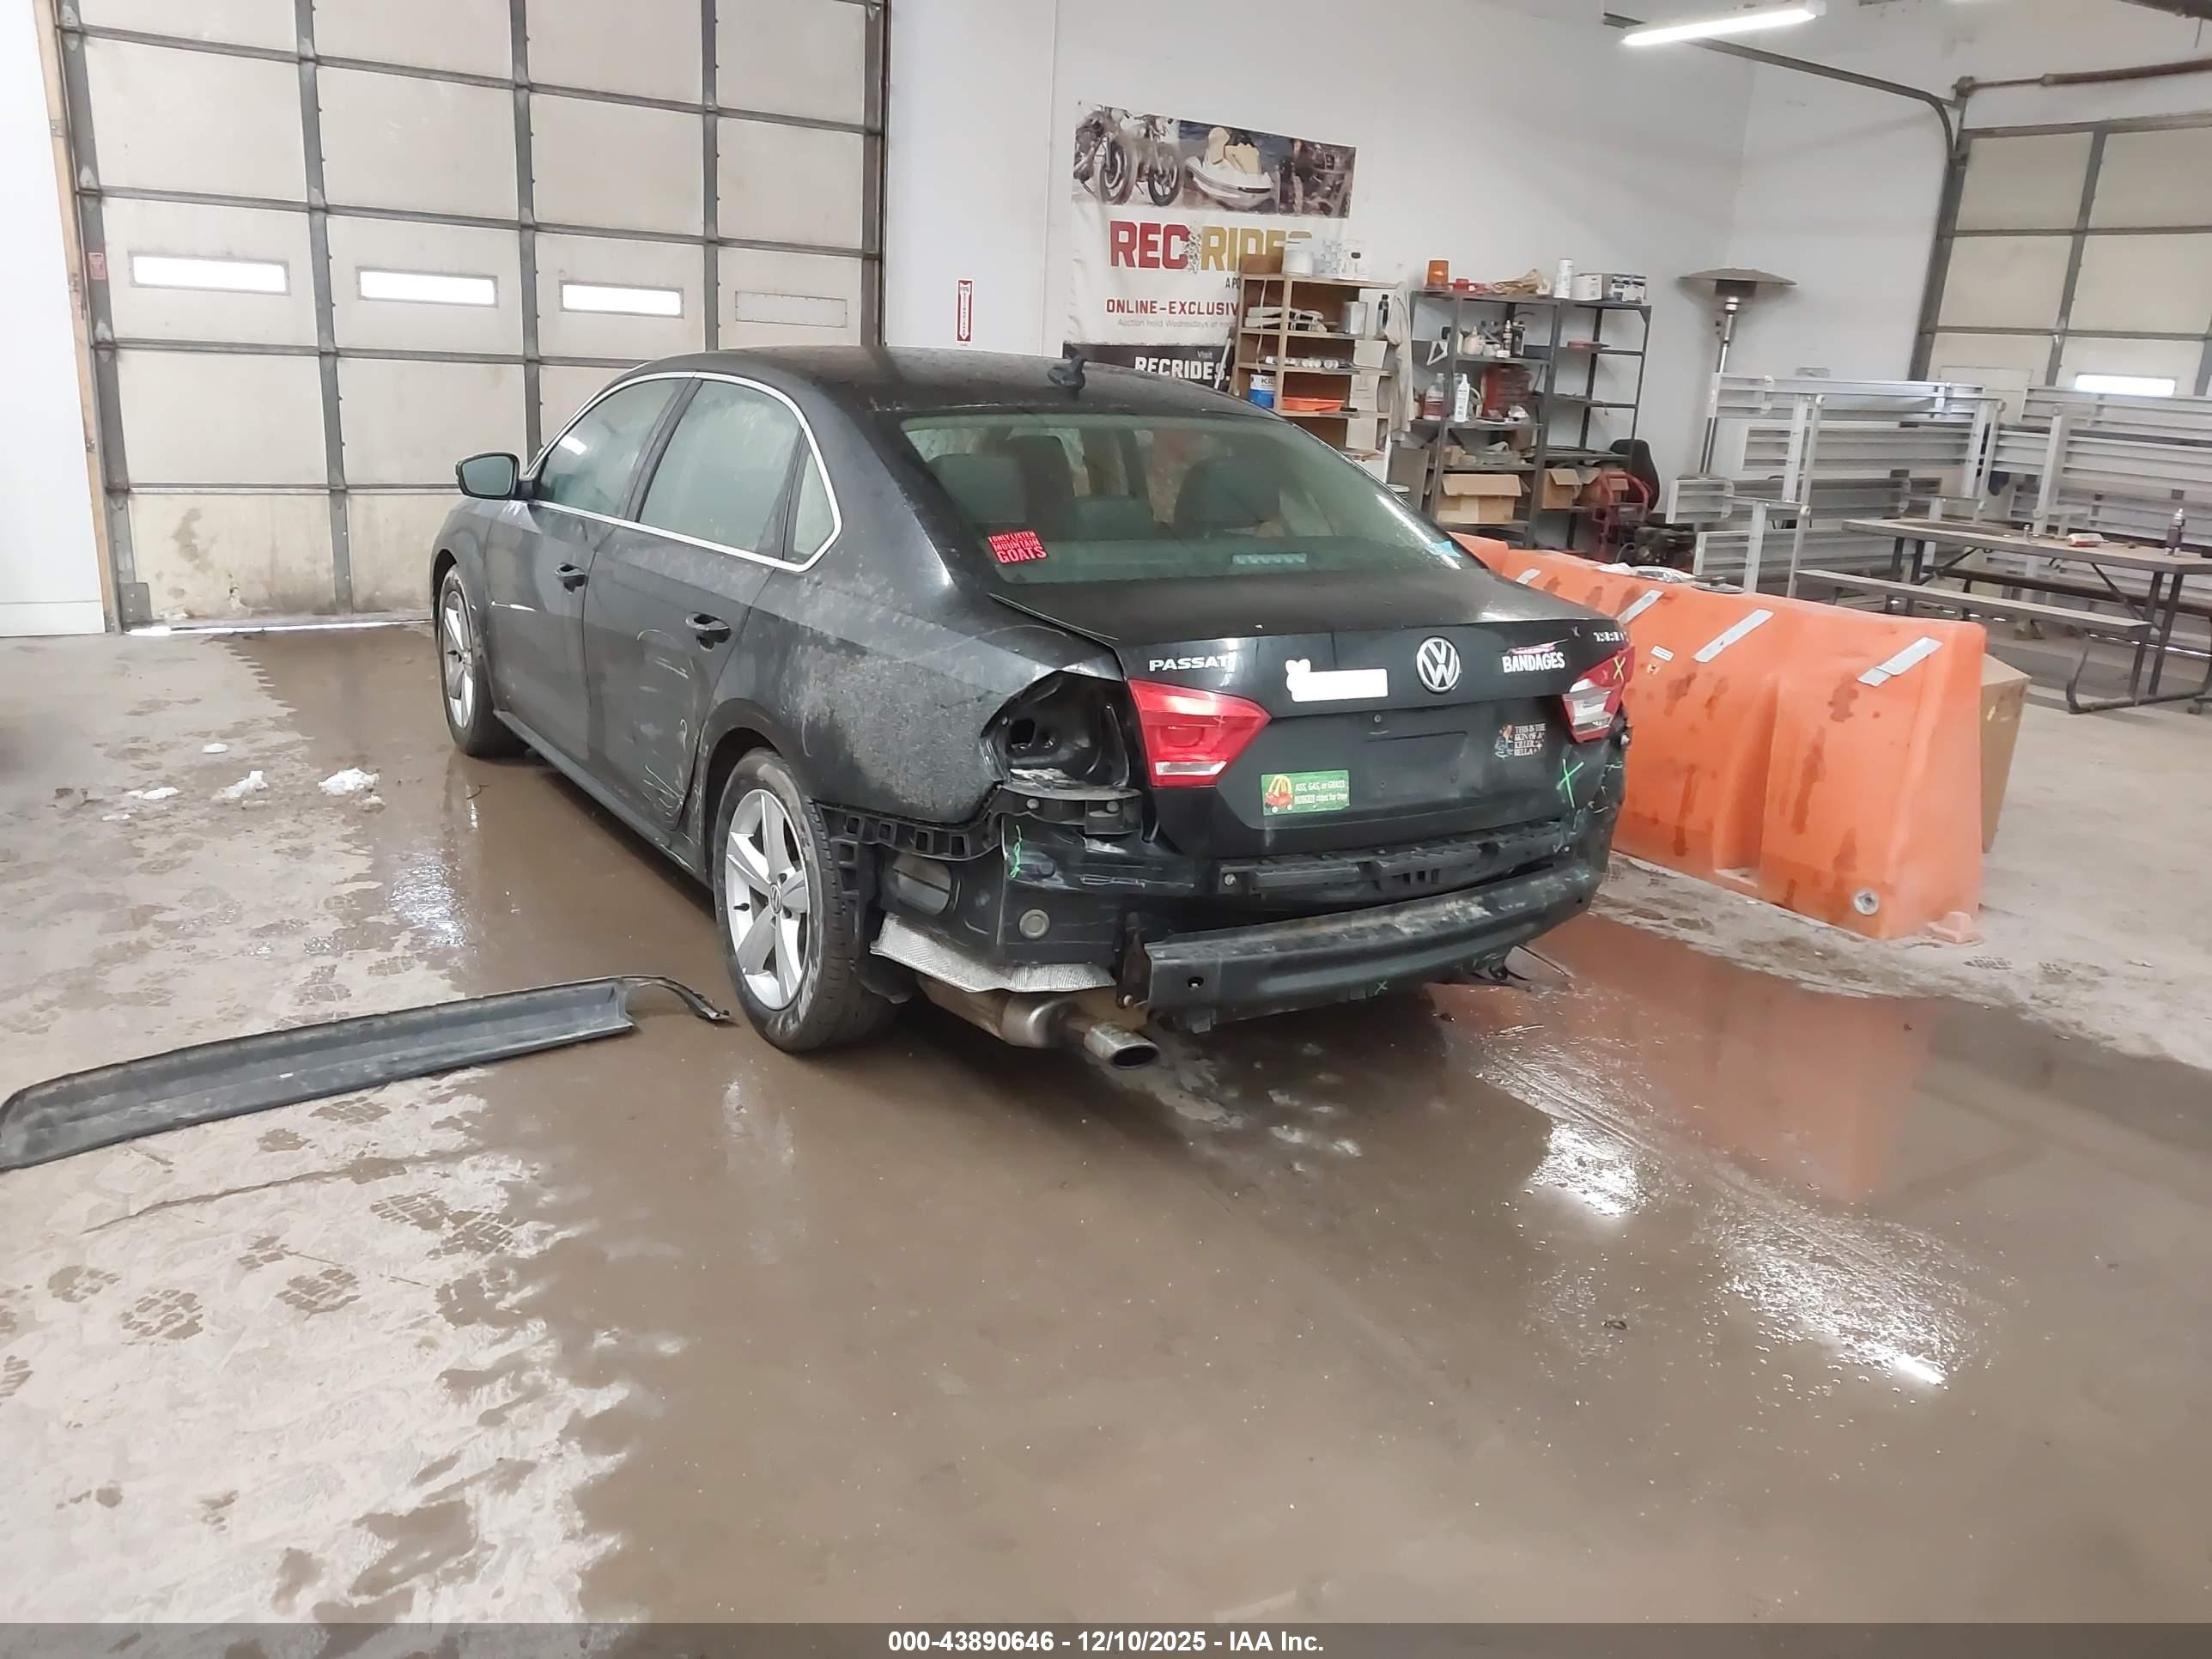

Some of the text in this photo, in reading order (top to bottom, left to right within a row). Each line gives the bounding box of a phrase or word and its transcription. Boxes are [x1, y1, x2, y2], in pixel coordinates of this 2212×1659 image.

[1109, 220, 1313, 271] REC RIDE
[1224, 276, 1231, 289] A
[1197, 350, 1212, 359] Visit
[993, 533, 1011, 542] ONLY
[1011, 530, 1036, 541] LISTEN
[993, 538, 1041, 552] MOUNTAIN
[996, 546, 1047, 563] GOATS
[1149, 655, 1231, 672] PASSAT
[1502, 652, 1565, 673] BANDAGES
[1535, 723, 1546, 732] THE
